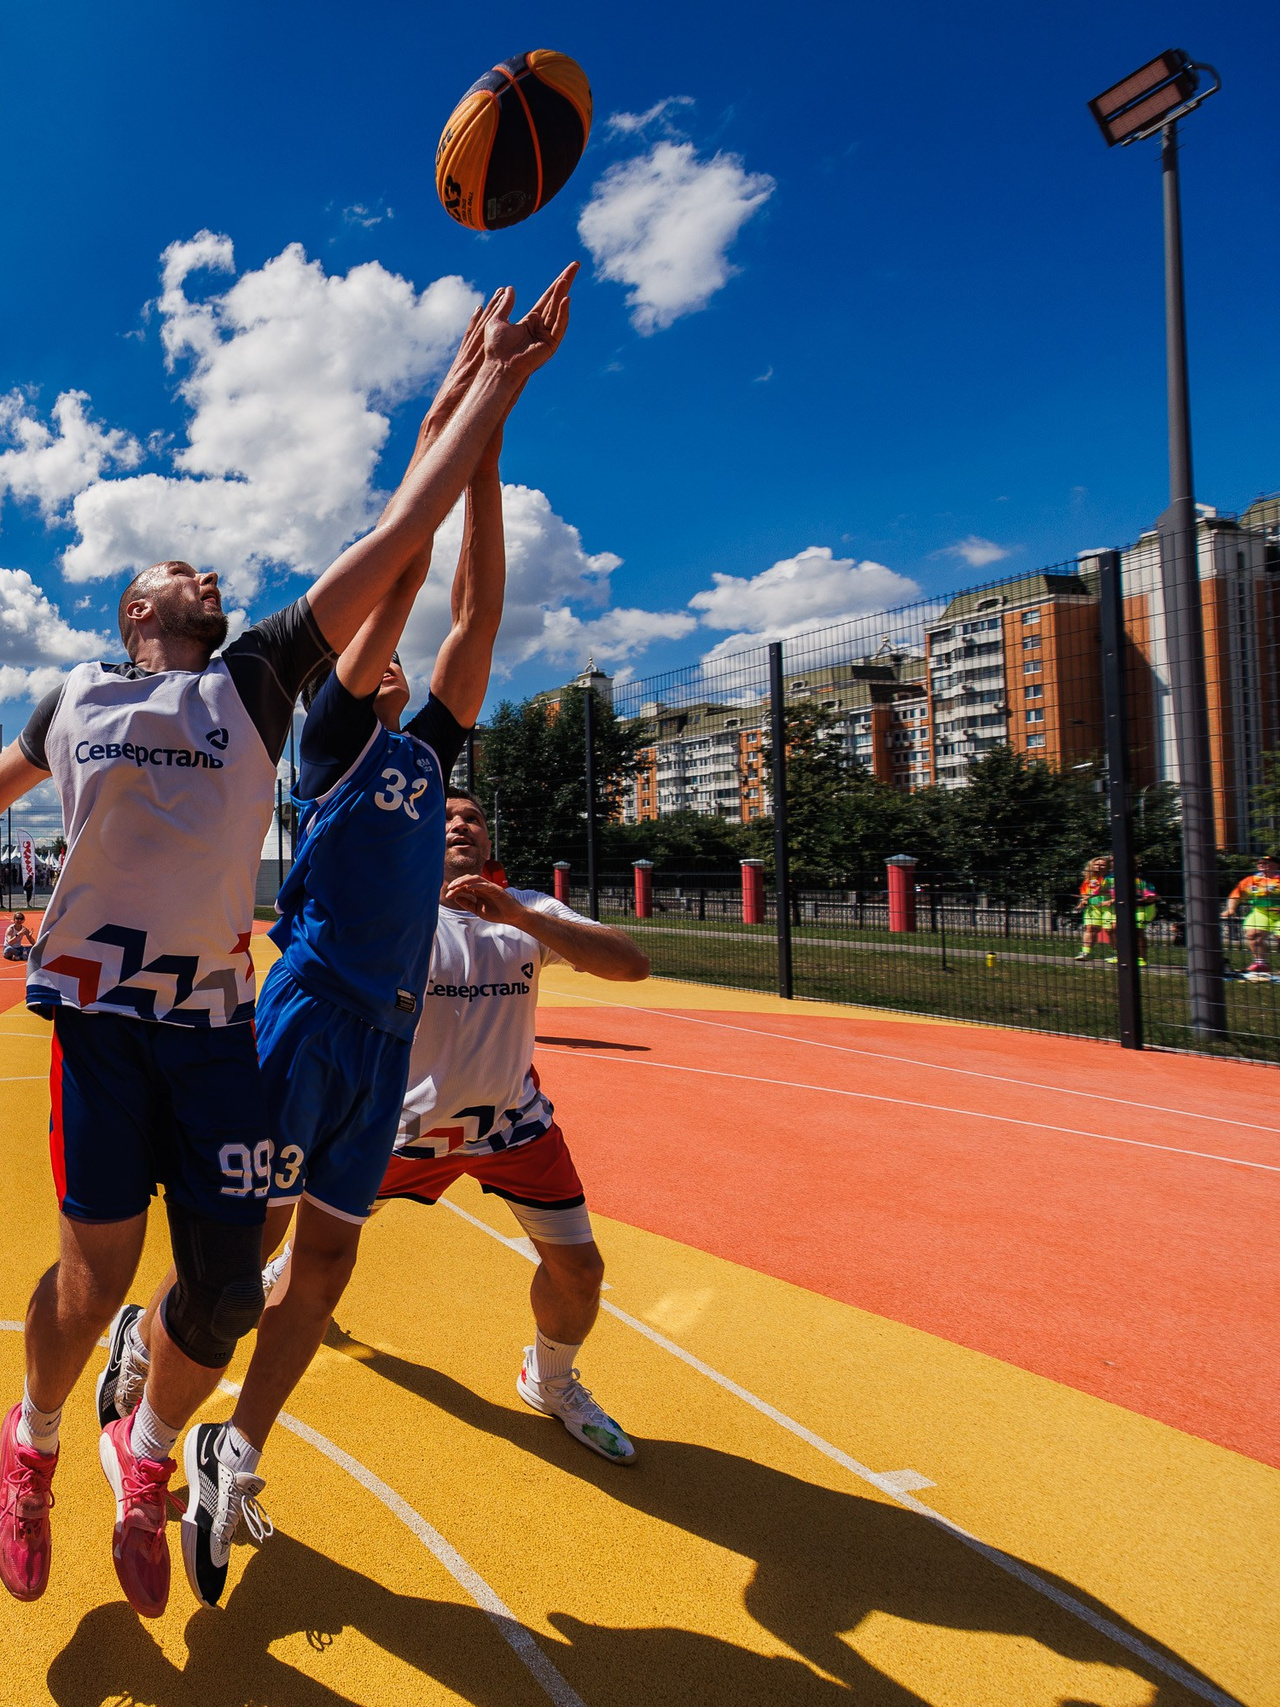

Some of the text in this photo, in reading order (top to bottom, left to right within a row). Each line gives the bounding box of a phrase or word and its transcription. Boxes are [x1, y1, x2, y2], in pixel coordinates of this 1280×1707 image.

[75, 740, 224, 769] Северсталь
[218, 1139, 270, 1198] 99
[269, 1138, 304, 1189] 3
